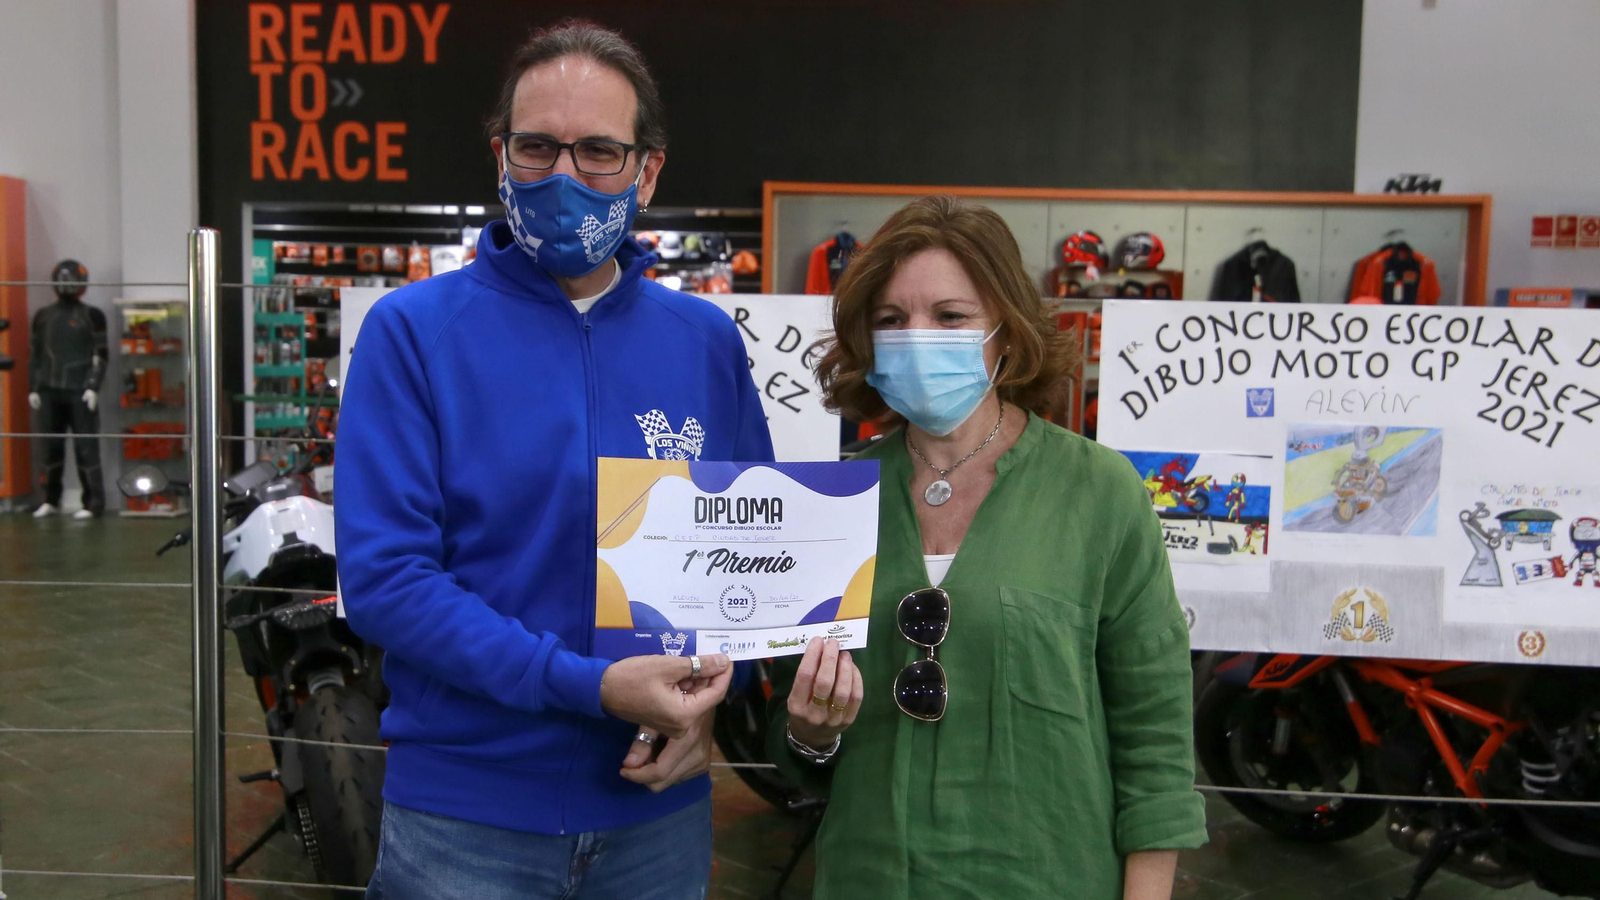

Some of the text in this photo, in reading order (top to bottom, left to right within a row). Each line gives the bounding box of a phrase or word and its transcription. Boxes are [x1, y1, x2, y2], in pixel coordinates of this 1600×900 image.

[249, 3, 450, 64] READY
[250, 63, 327, 121] TO
[251, 121, 408, 182] RACE
[1384, 175, 1443, 194] KTM
[591, 231, 604, 245] LOS
[1155, 310, 1369, 353] CONCURSO
[1385, 312, 1560, 366] ESCOLAR
[1576, 338, 1600, 367] D
[1119, 347, 1600, 423] DIBUJO MOTO GP JEREZ
[1477, 392, 1565, 448] 2021
[657, 439, 673, 448] LOS
[694, 496, 783, 524] DIPLOMA
[705, 547, 797, 577] Premio
[727, 598, 748, 606] 2021
[1350, 601, 1364, 629] 1
[1525, 636, 1537, 650] 3
